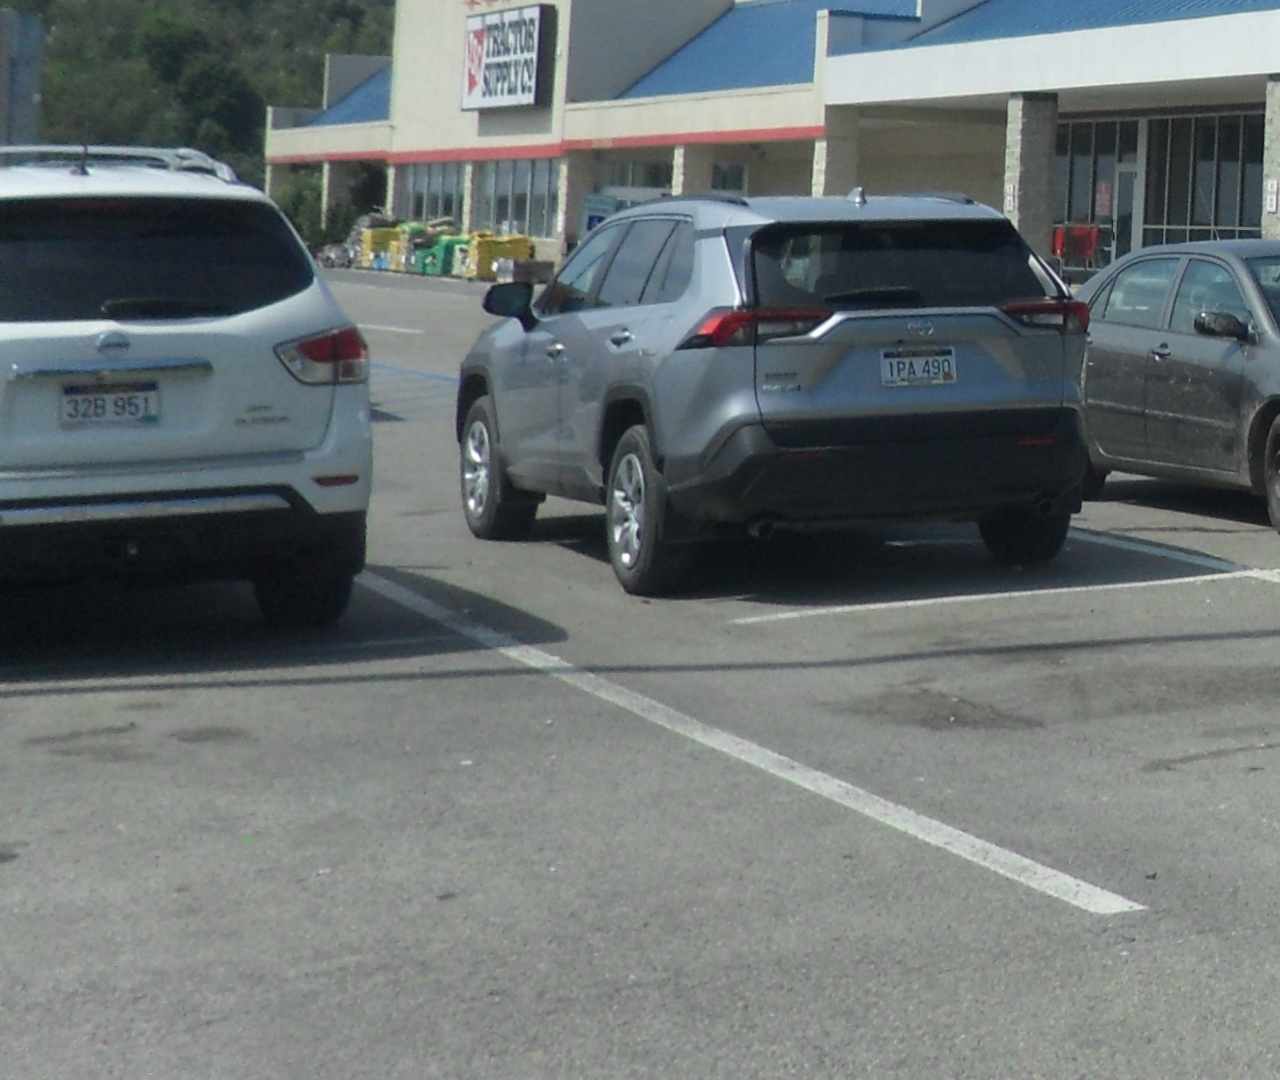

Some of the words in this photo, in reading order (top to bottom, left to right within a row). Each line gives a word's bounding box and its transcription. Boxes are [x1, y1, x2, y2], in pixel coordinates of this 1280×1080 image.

[486, 18, 535, 58] TRACTOR
[482, 60, 519, 97] SUPPLY
[66, 396, 107, 419] 32B
[112, 395, 150, 418] 951
